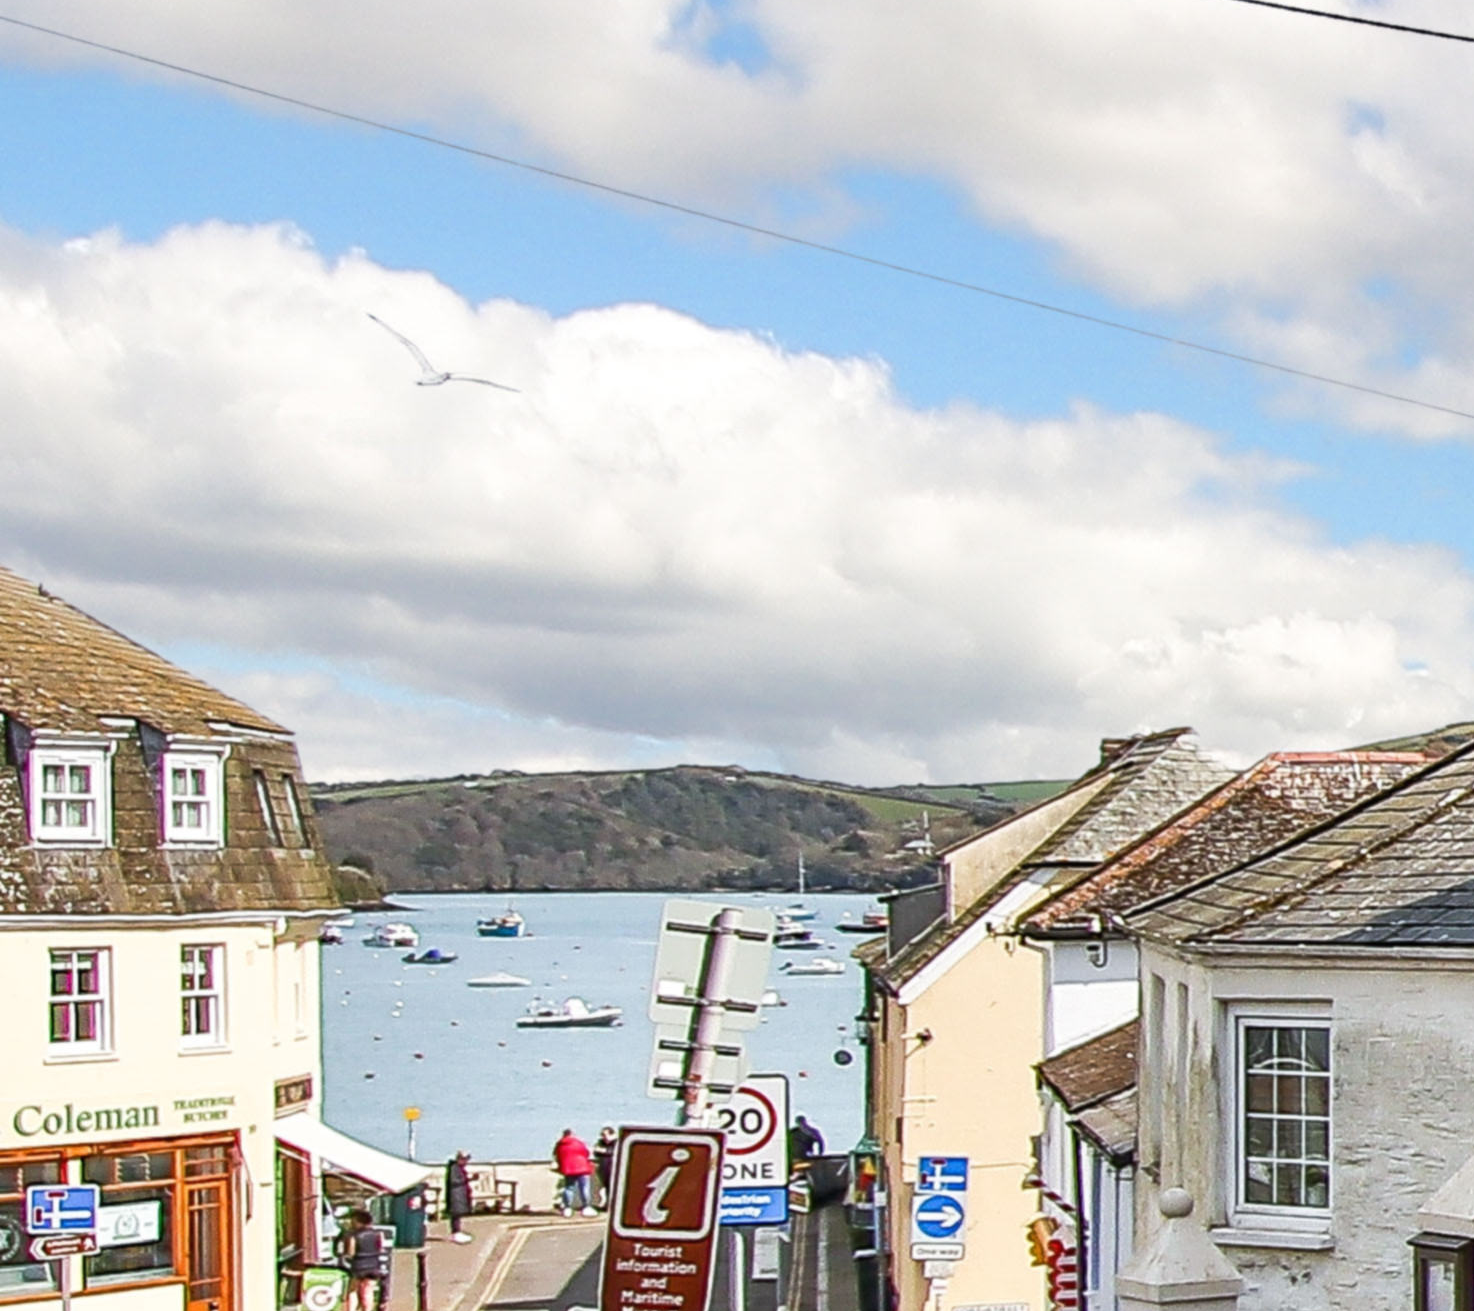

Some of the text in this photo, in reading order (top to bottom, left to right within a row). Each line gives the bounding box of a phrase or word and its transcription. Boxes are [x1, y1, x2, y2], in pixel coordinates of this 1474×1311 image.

[13, 1103, 160, 1137] Coleman
[717, 1107, 764, 1135] 20
[722, 1162, 774, 1180] ONE
[632, 1243, 683, 1258] Tourist
[615, 1258, 697, 1275] information
[639, 1276, 668, 1290] and
[620, 1291, 684, 1306] Maritime
